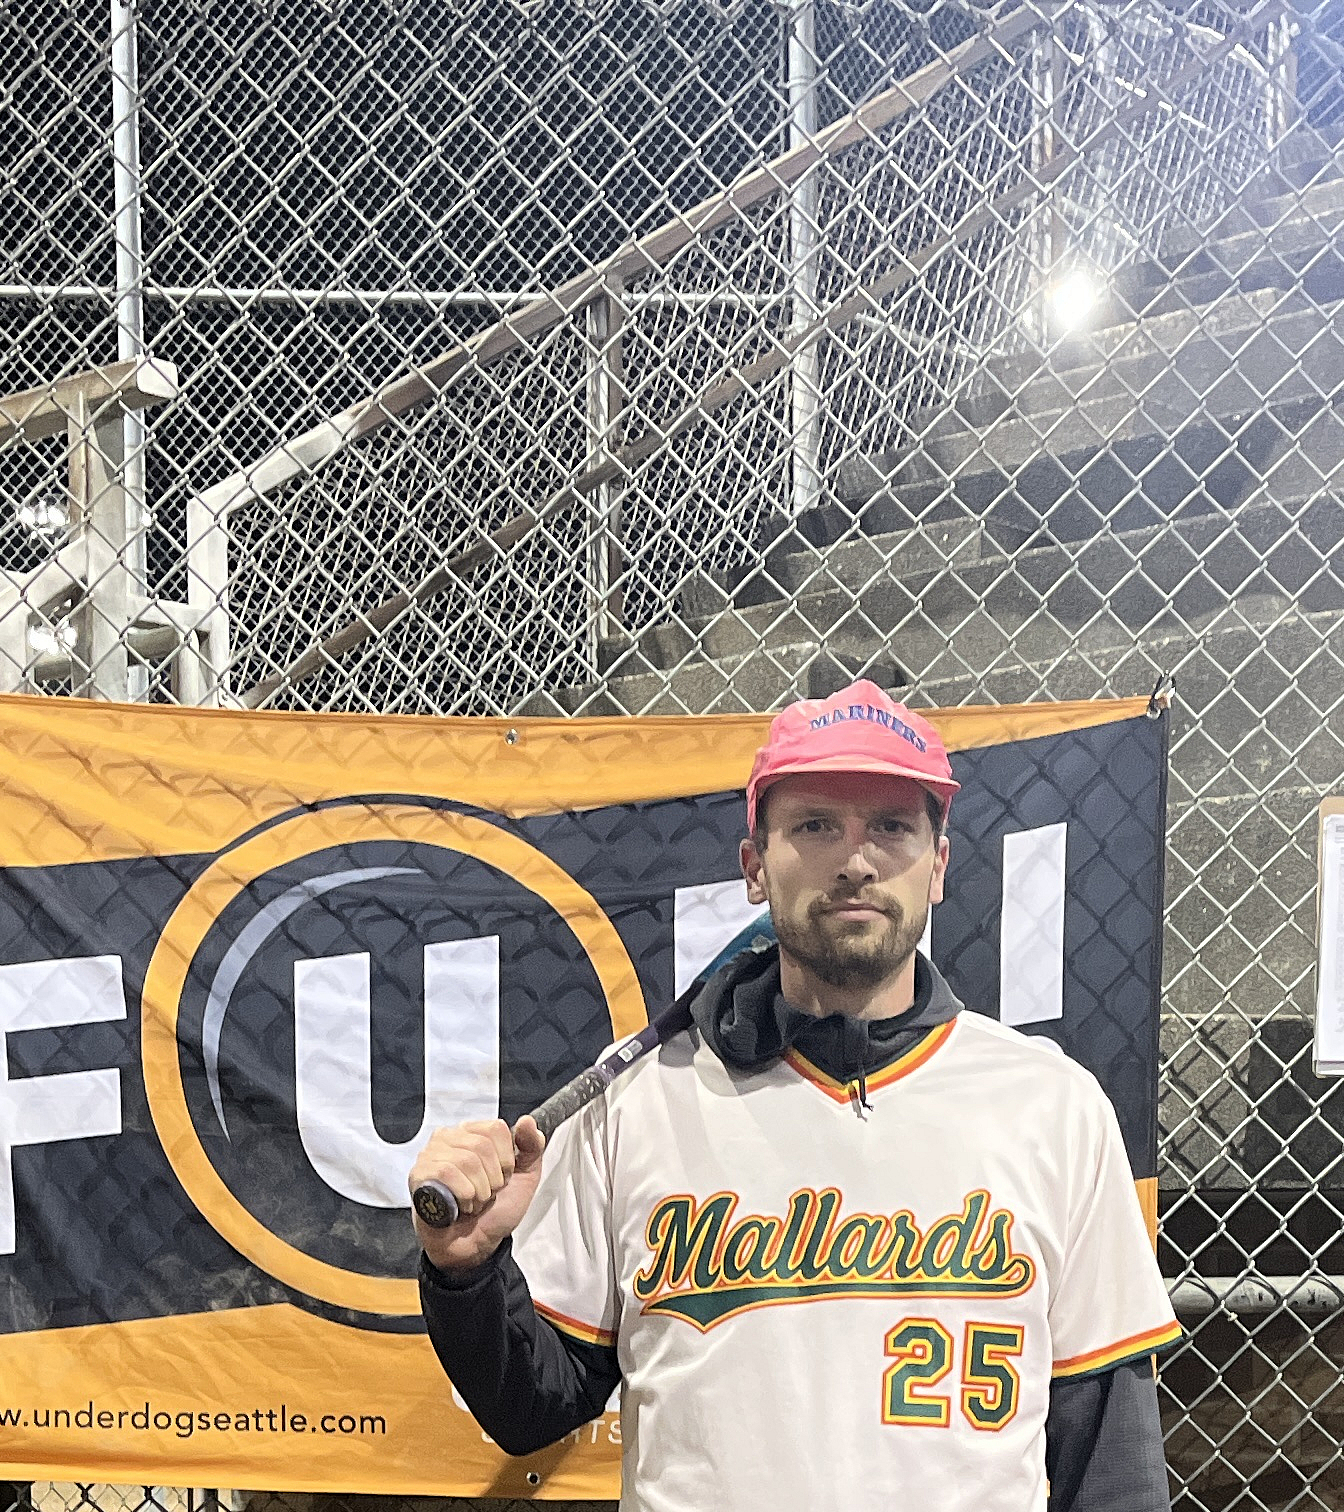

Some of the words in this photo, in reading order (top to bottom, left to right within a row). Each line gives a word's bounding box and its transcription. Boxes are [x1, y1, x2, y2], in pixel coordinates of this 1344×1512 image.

[809, 704, 927, 753] MARINERS
[633, 1187, 1035, 1304] Mallards
[881, 1317, 1025, 1433] 25
